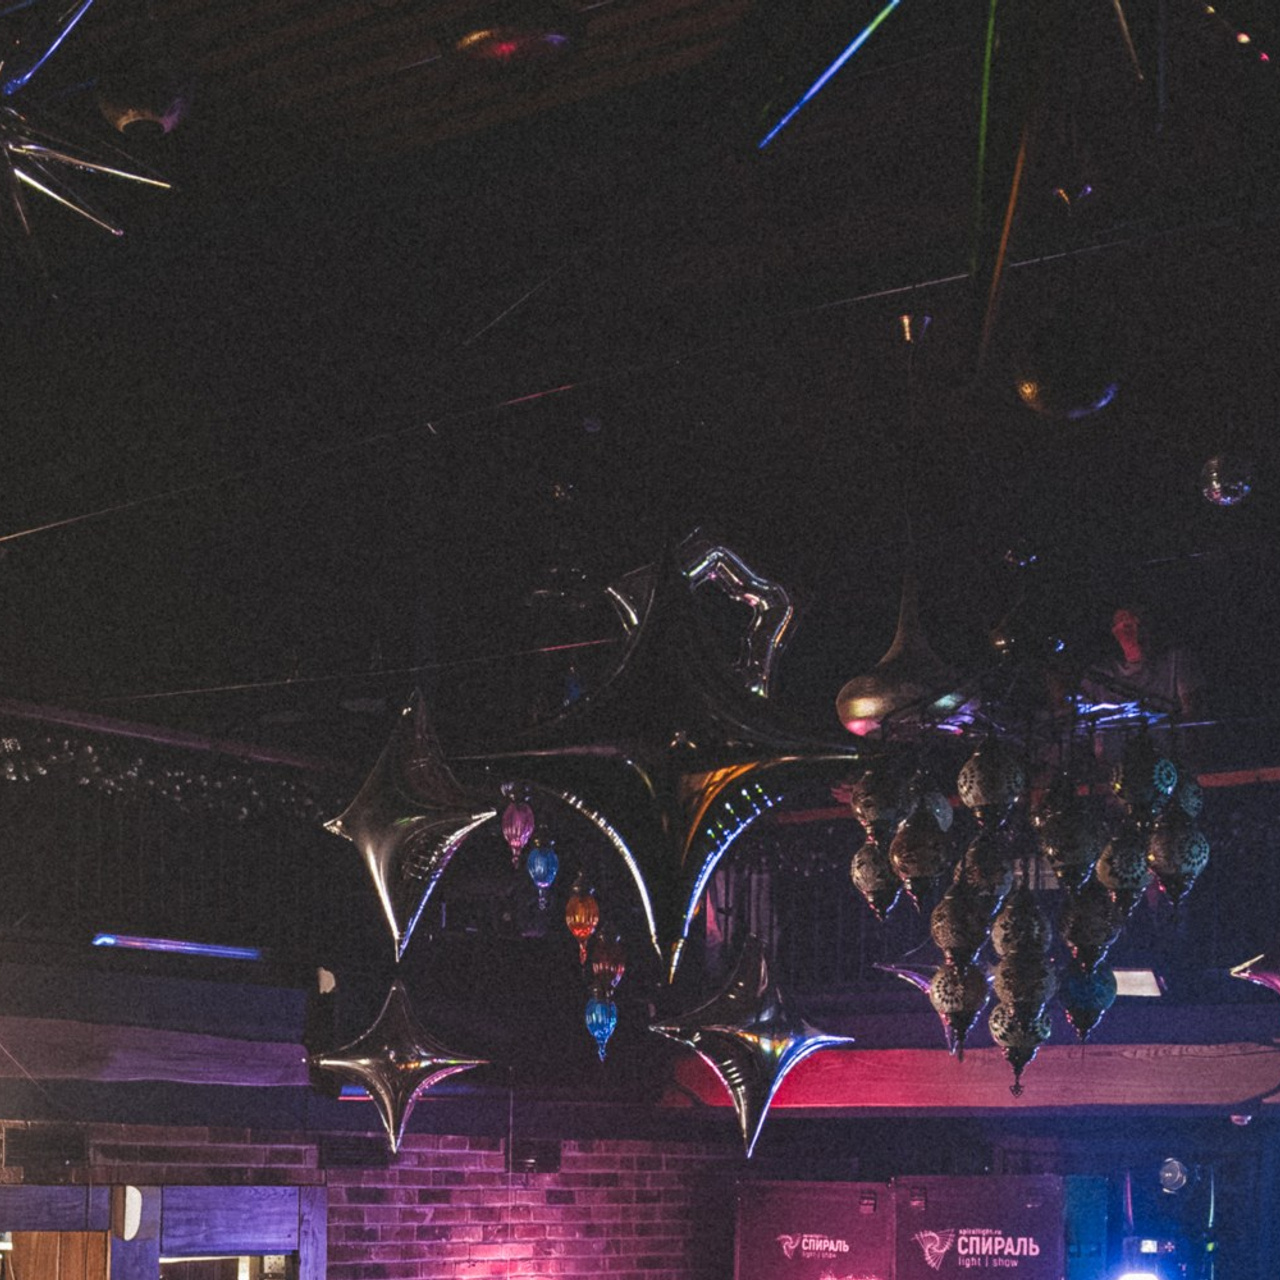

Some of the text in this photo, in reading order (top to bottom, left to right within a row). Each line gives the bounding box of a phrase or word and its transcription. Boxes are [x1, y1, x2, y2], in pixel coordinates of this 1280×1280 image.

[802, 1238, 850, 1252] СПИРАЛЬ
[957, 1236, 1040, 1256] СПИРАЛЬ
[958, 1257, 1019, 1268] light show
